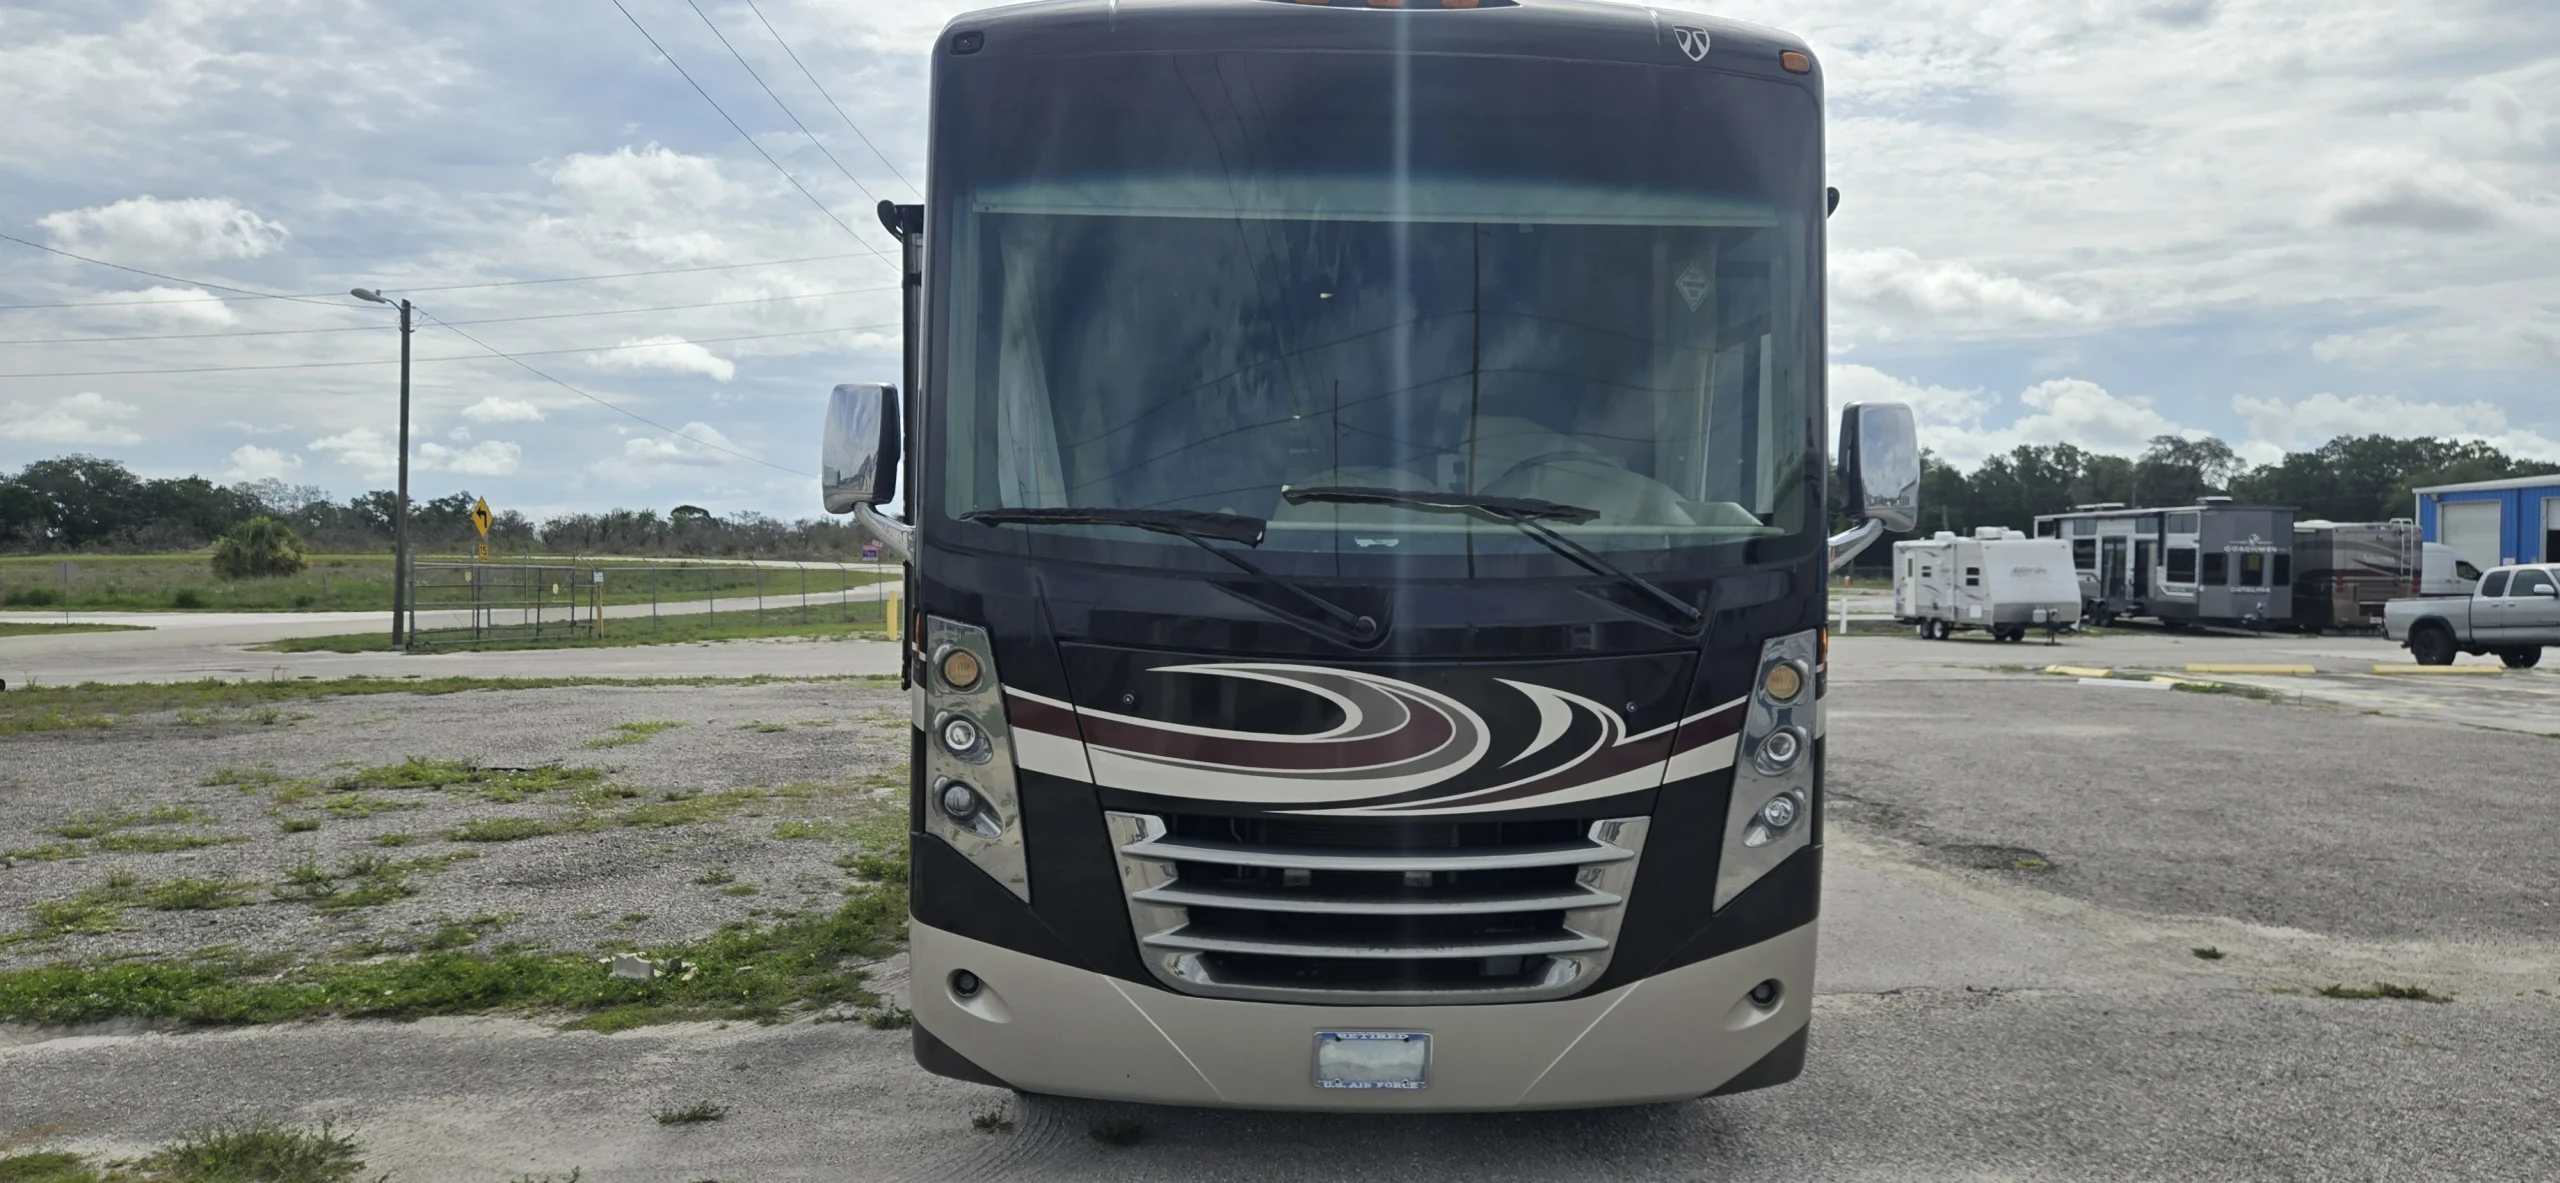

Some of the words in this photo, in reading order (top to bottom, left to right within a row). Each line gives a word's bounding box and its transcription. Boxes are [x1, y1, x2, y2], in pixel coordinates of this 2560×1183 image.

[479, 545, 487, 556] 15
[1336, 1032, 1409, 1040] RETIRED
[1323, 1081, 1346, 1089] U.S.
[1348, 1081, 1371, 1089] AIR
[1375, 1081, 1419, 1089] FORCE
